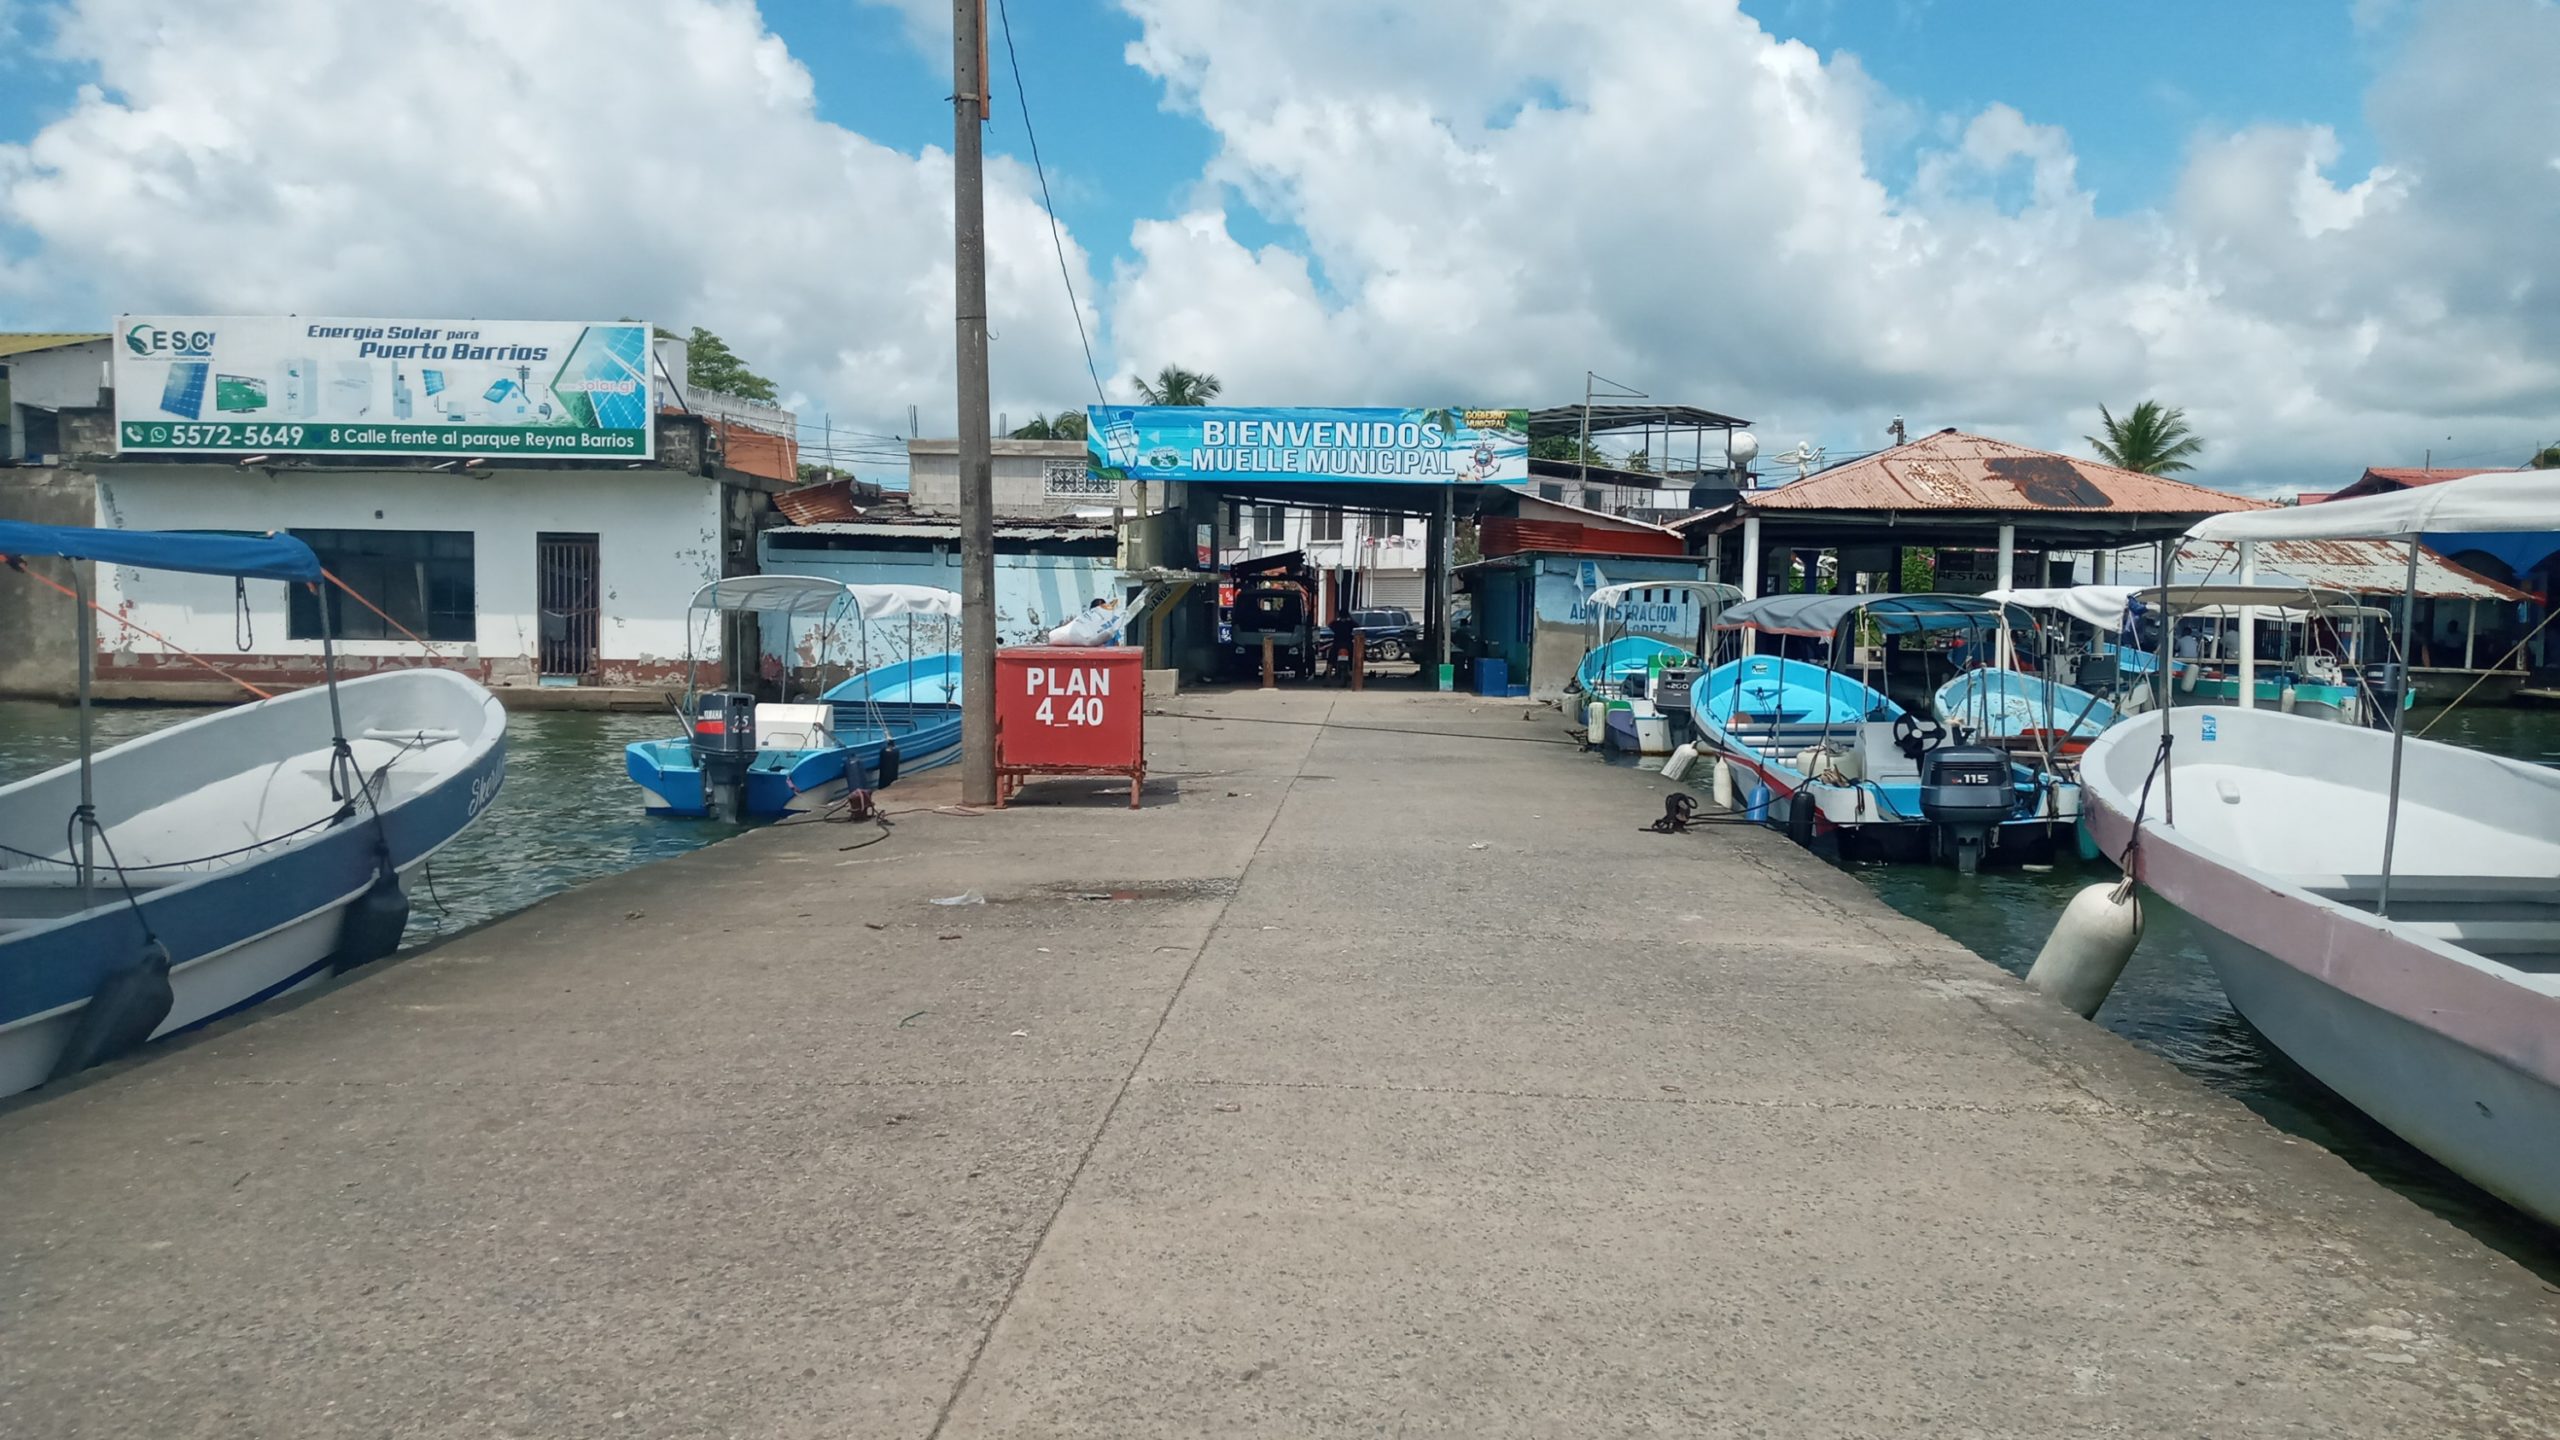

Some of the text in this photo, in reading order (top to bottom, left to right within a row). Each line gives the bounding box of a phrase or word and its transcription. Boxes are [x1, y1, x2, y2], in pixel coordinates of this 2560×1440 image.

[387, 326, 442, 340] Solar
[446, 330, 479, 340] para
[359, 342, 548, 361] Puerto Barrios
[171, 425, 634, 449] 5572-5649 8 Calle frente al parque Reyna Barrios
[1202, 420, 1443, 449] BIENVENIDOS
[1191, 449, 1455, 475] MUELLE MUNICIPAL
[1026, 667, 1110, 696] PLAN
[1035, 697, 1104, 727] 4_40
[1963, 774, 1989, 784] 115
